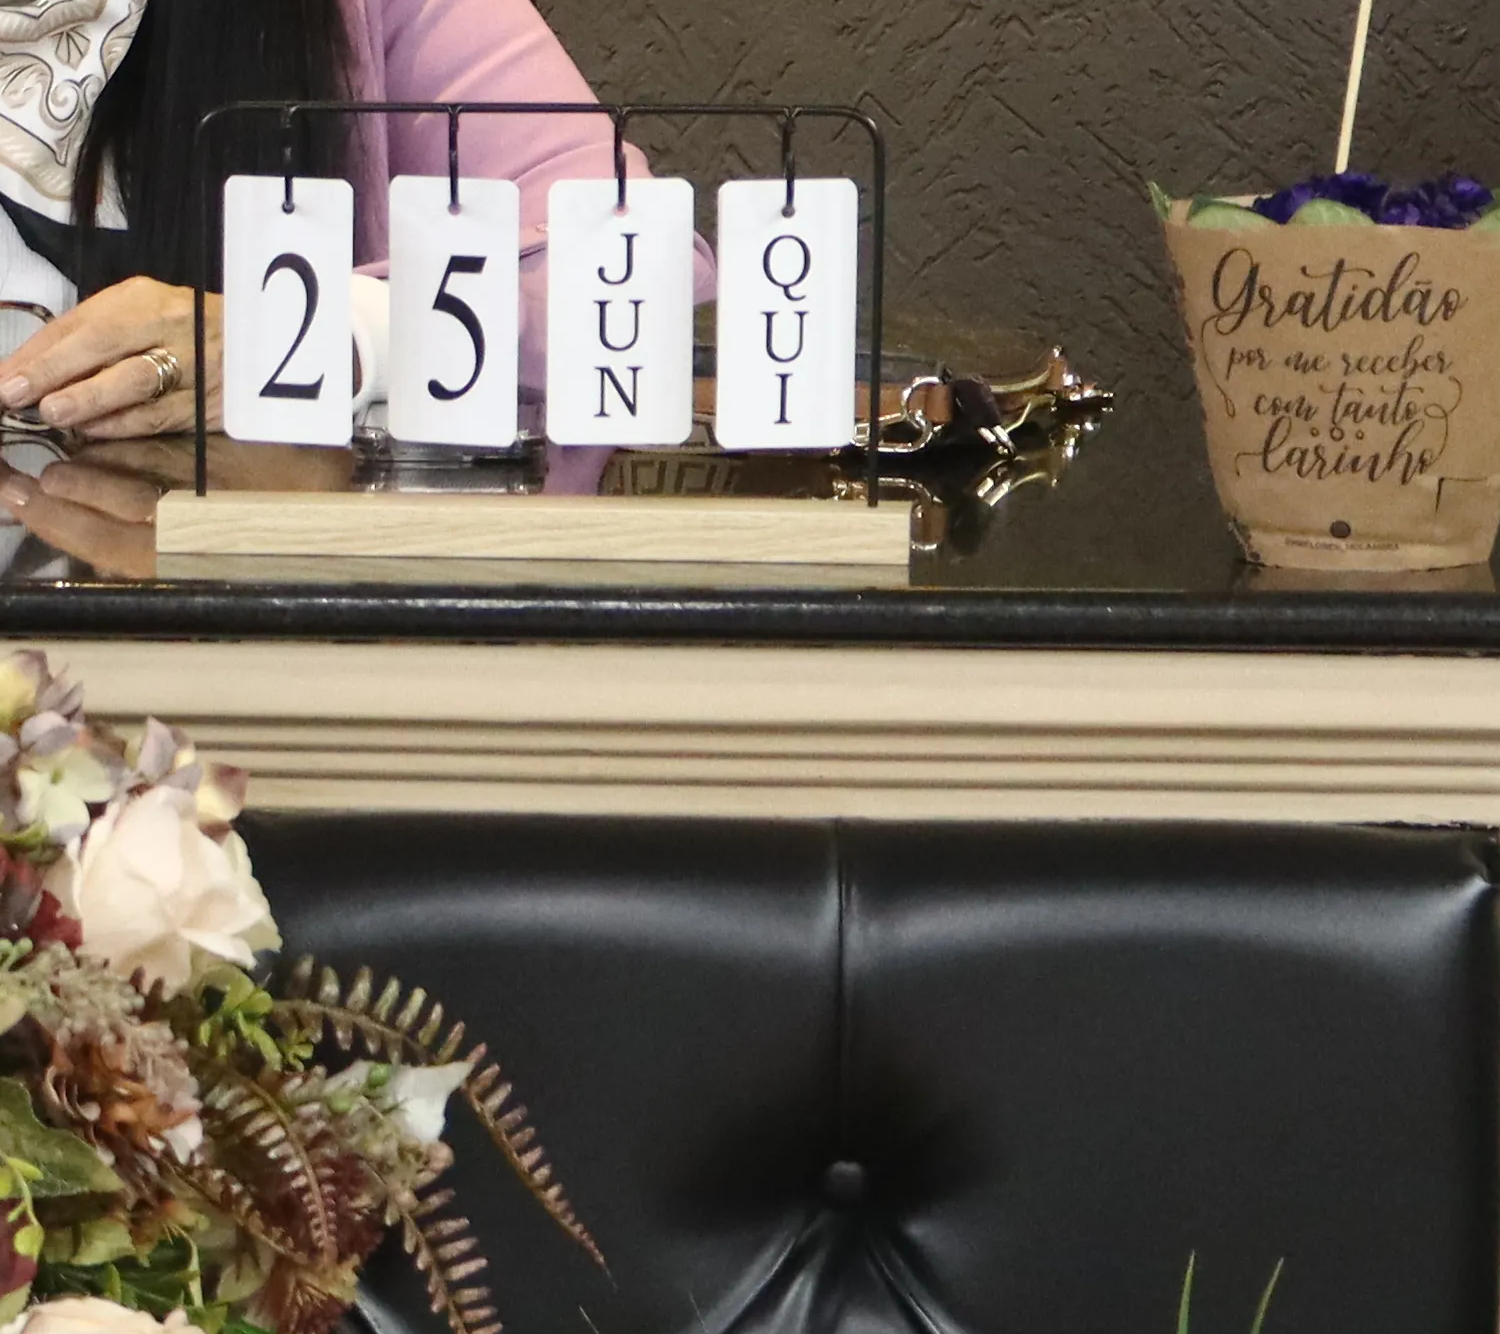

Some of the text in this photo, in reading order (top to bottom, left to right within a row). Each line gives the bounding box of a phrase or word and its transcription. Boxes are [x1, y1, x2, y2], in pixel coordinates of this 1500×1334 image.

[593, 233, 645, 419] JUN
[760, 234, 812, 425] QUI
[1209, 247, 1468, 335] Gratidão
[1226, 334, 1454, 381] por me receber
[1253, 381, 1425, 428] com tanto
